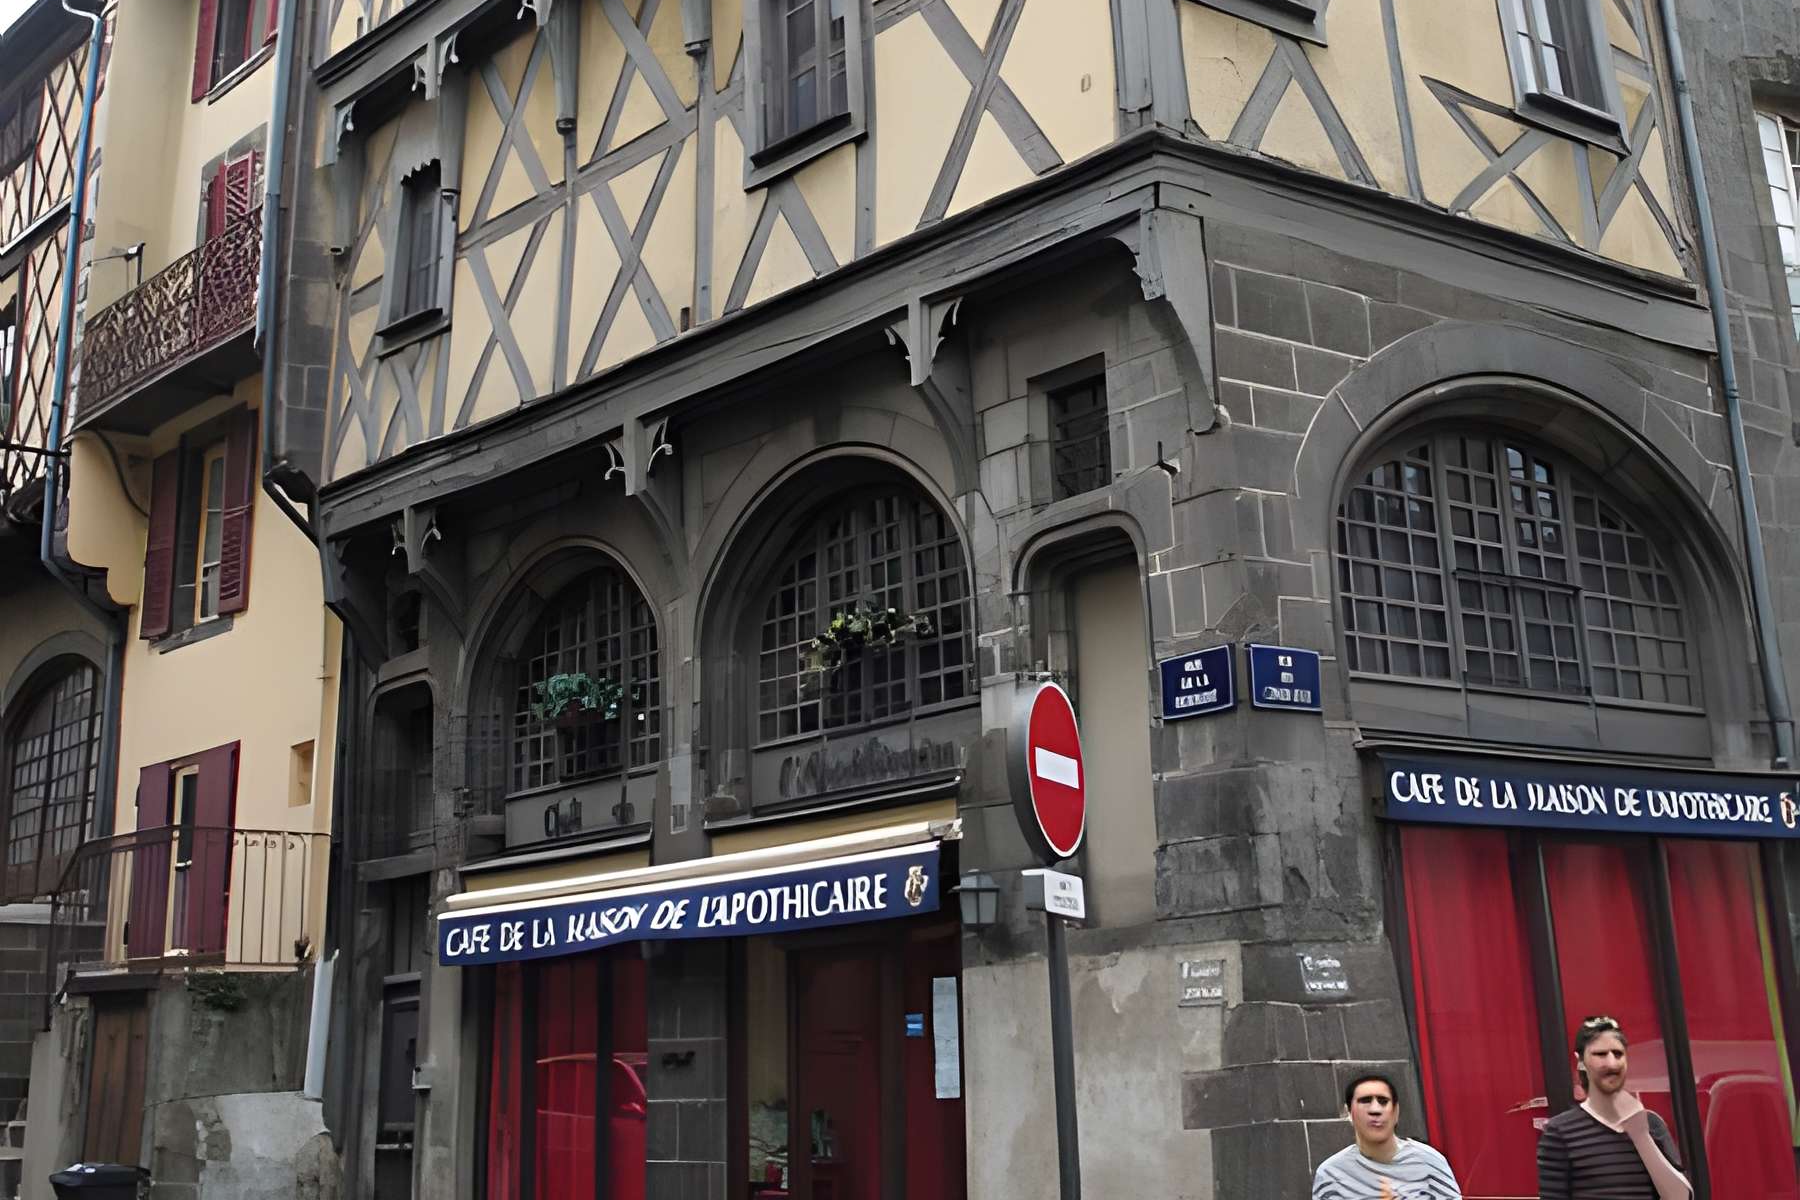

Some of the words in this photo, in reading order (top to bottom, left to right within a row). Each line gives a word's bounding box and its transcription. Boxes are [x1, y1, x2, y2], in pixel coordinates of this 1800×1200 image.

[1455, 776, 1484, 808] DE
[1490, 779, 1518, 810] LA
[1614, 787, 1642, 817] DE
[446, 923, 491, 956] CAFE
[500, 921, 525, 951] DE
[532, 917, 556, 949] LA
[650, 899, 690, 930] DE
